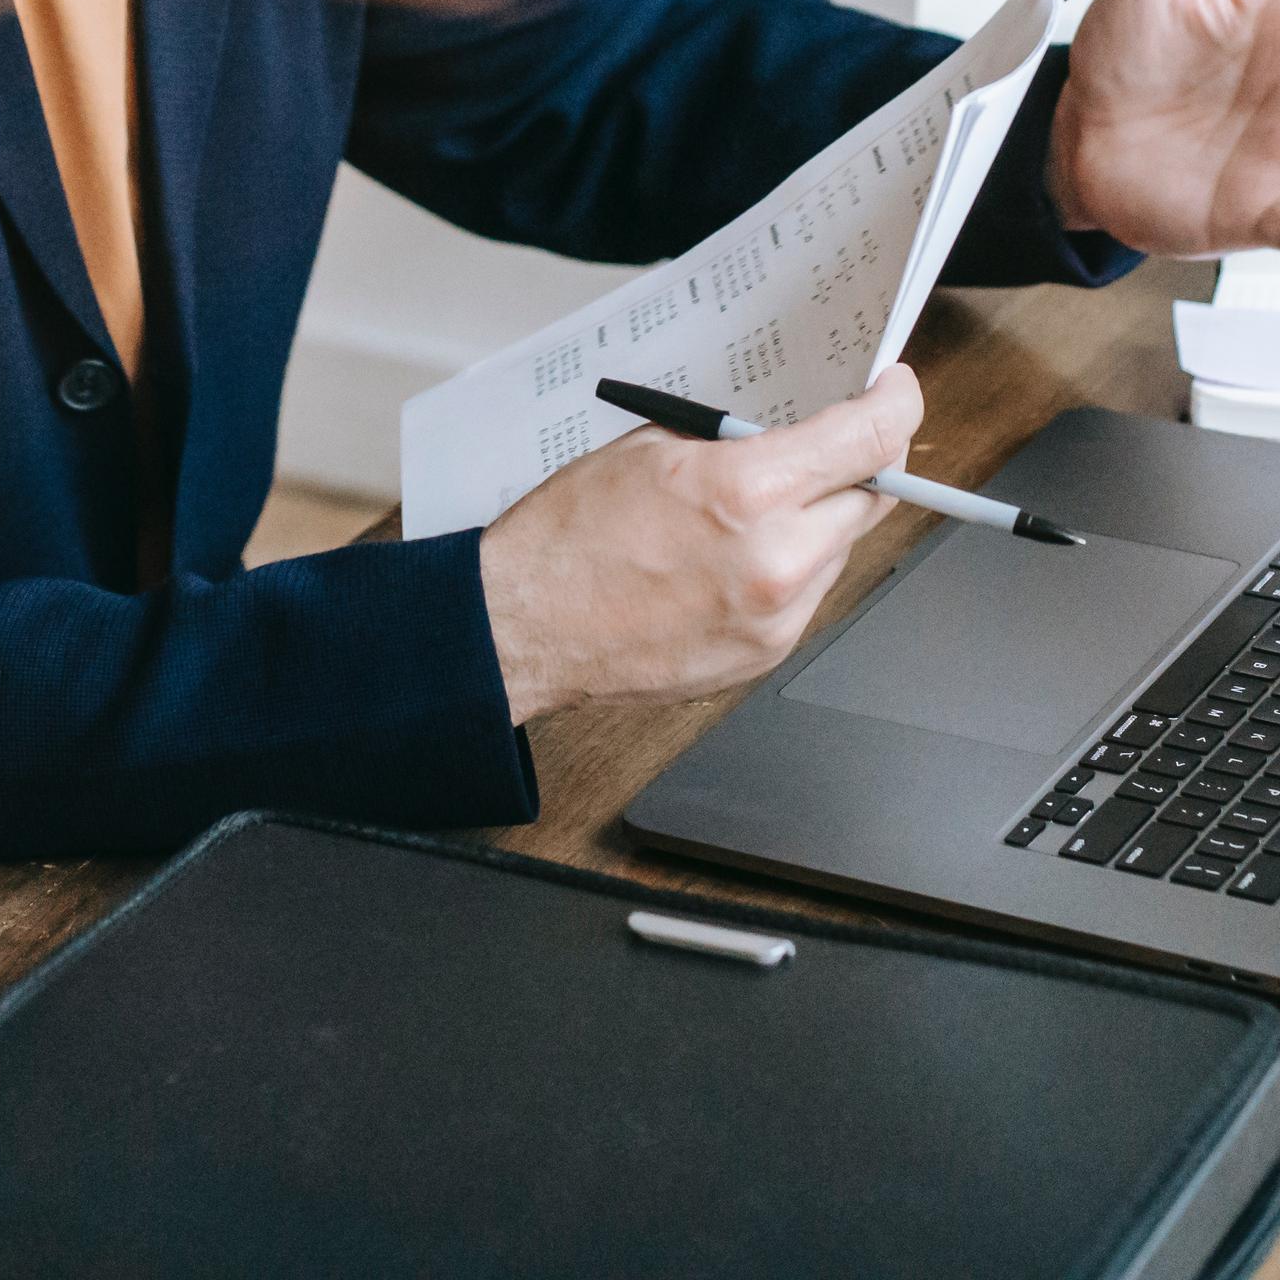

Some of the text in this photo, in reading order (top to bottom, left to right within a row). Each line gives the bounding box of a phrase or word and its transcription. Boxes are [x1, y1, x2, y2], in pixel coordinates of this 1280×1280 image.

[1230, 685, 1246, 694] N
[1207, 708, 1224, 718] M
[1250, 733, 1266, 741] K
[1268, 788, 1280, 796] P
